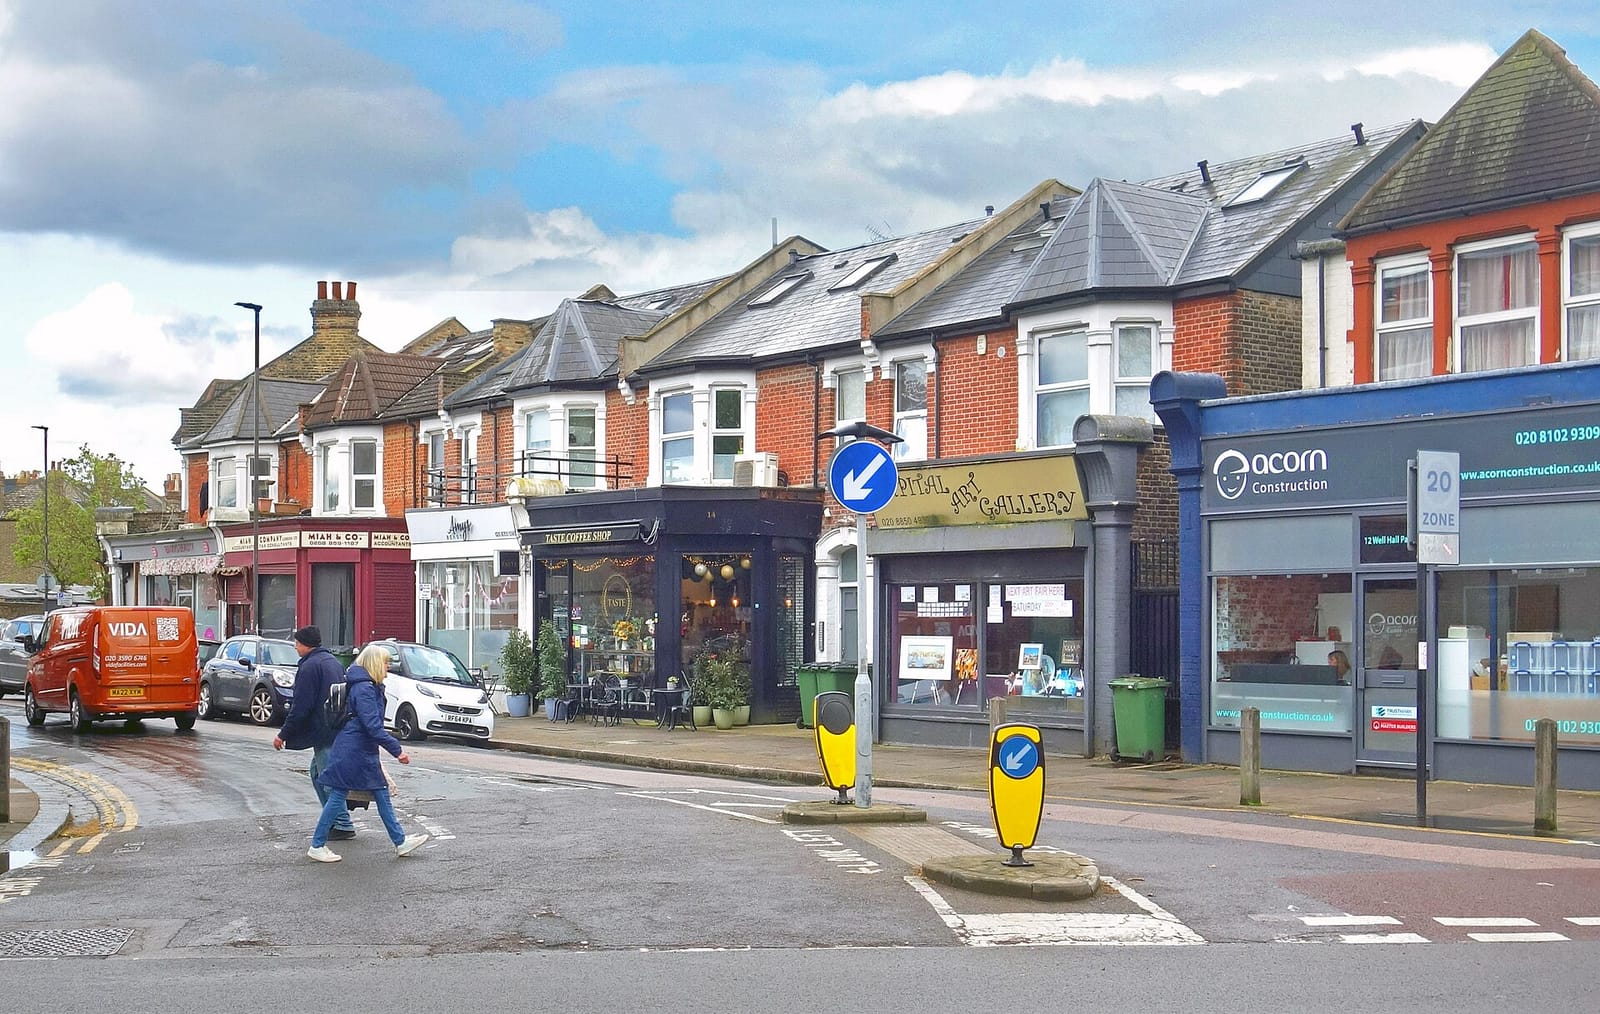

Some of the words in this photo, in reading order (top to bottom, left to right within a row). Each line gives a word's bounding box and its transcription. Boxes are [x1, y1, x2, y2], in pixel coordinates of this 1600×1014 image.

[1515, 431, 1537, 445] 020
[1539, 428, 1568, 443] 8102
[1570, 426, 1600, 441] 9309
[1252, 449, 1328, 475] acorn
[1460, 461, 1600, 480] ww.acornconstruction.co.uk
[895, 473, 950, 497] PITAL
[1252, 479, 1328, 494] Construction
[1427, 470, 1452, 492] 20
[951, 471, 982, 514] ART
[979, 491, 1076, 520] GALLERY
[881, 518, 894, 526] 020
[1422, 512, 1455, 526] ZONE
[545, 534, 565, 544] TASTE
[566, 532, 592, 543] COFFEE
[593, 531, 612, 541] SHOP
[1364, 537, 1372, 545] 12
[1372, 536, 1386, 545] Well
[1386, 535, 1399, 544] Hall
[1400, 535, 1409, 544] Pa
[608, 599, 626, 608] TASTE
[108, 622, 148, 637] VIDA
[1216, 709, 1335, 722] www.aconstruction.co.uk
[1556, 720, 1577, 733] 102
